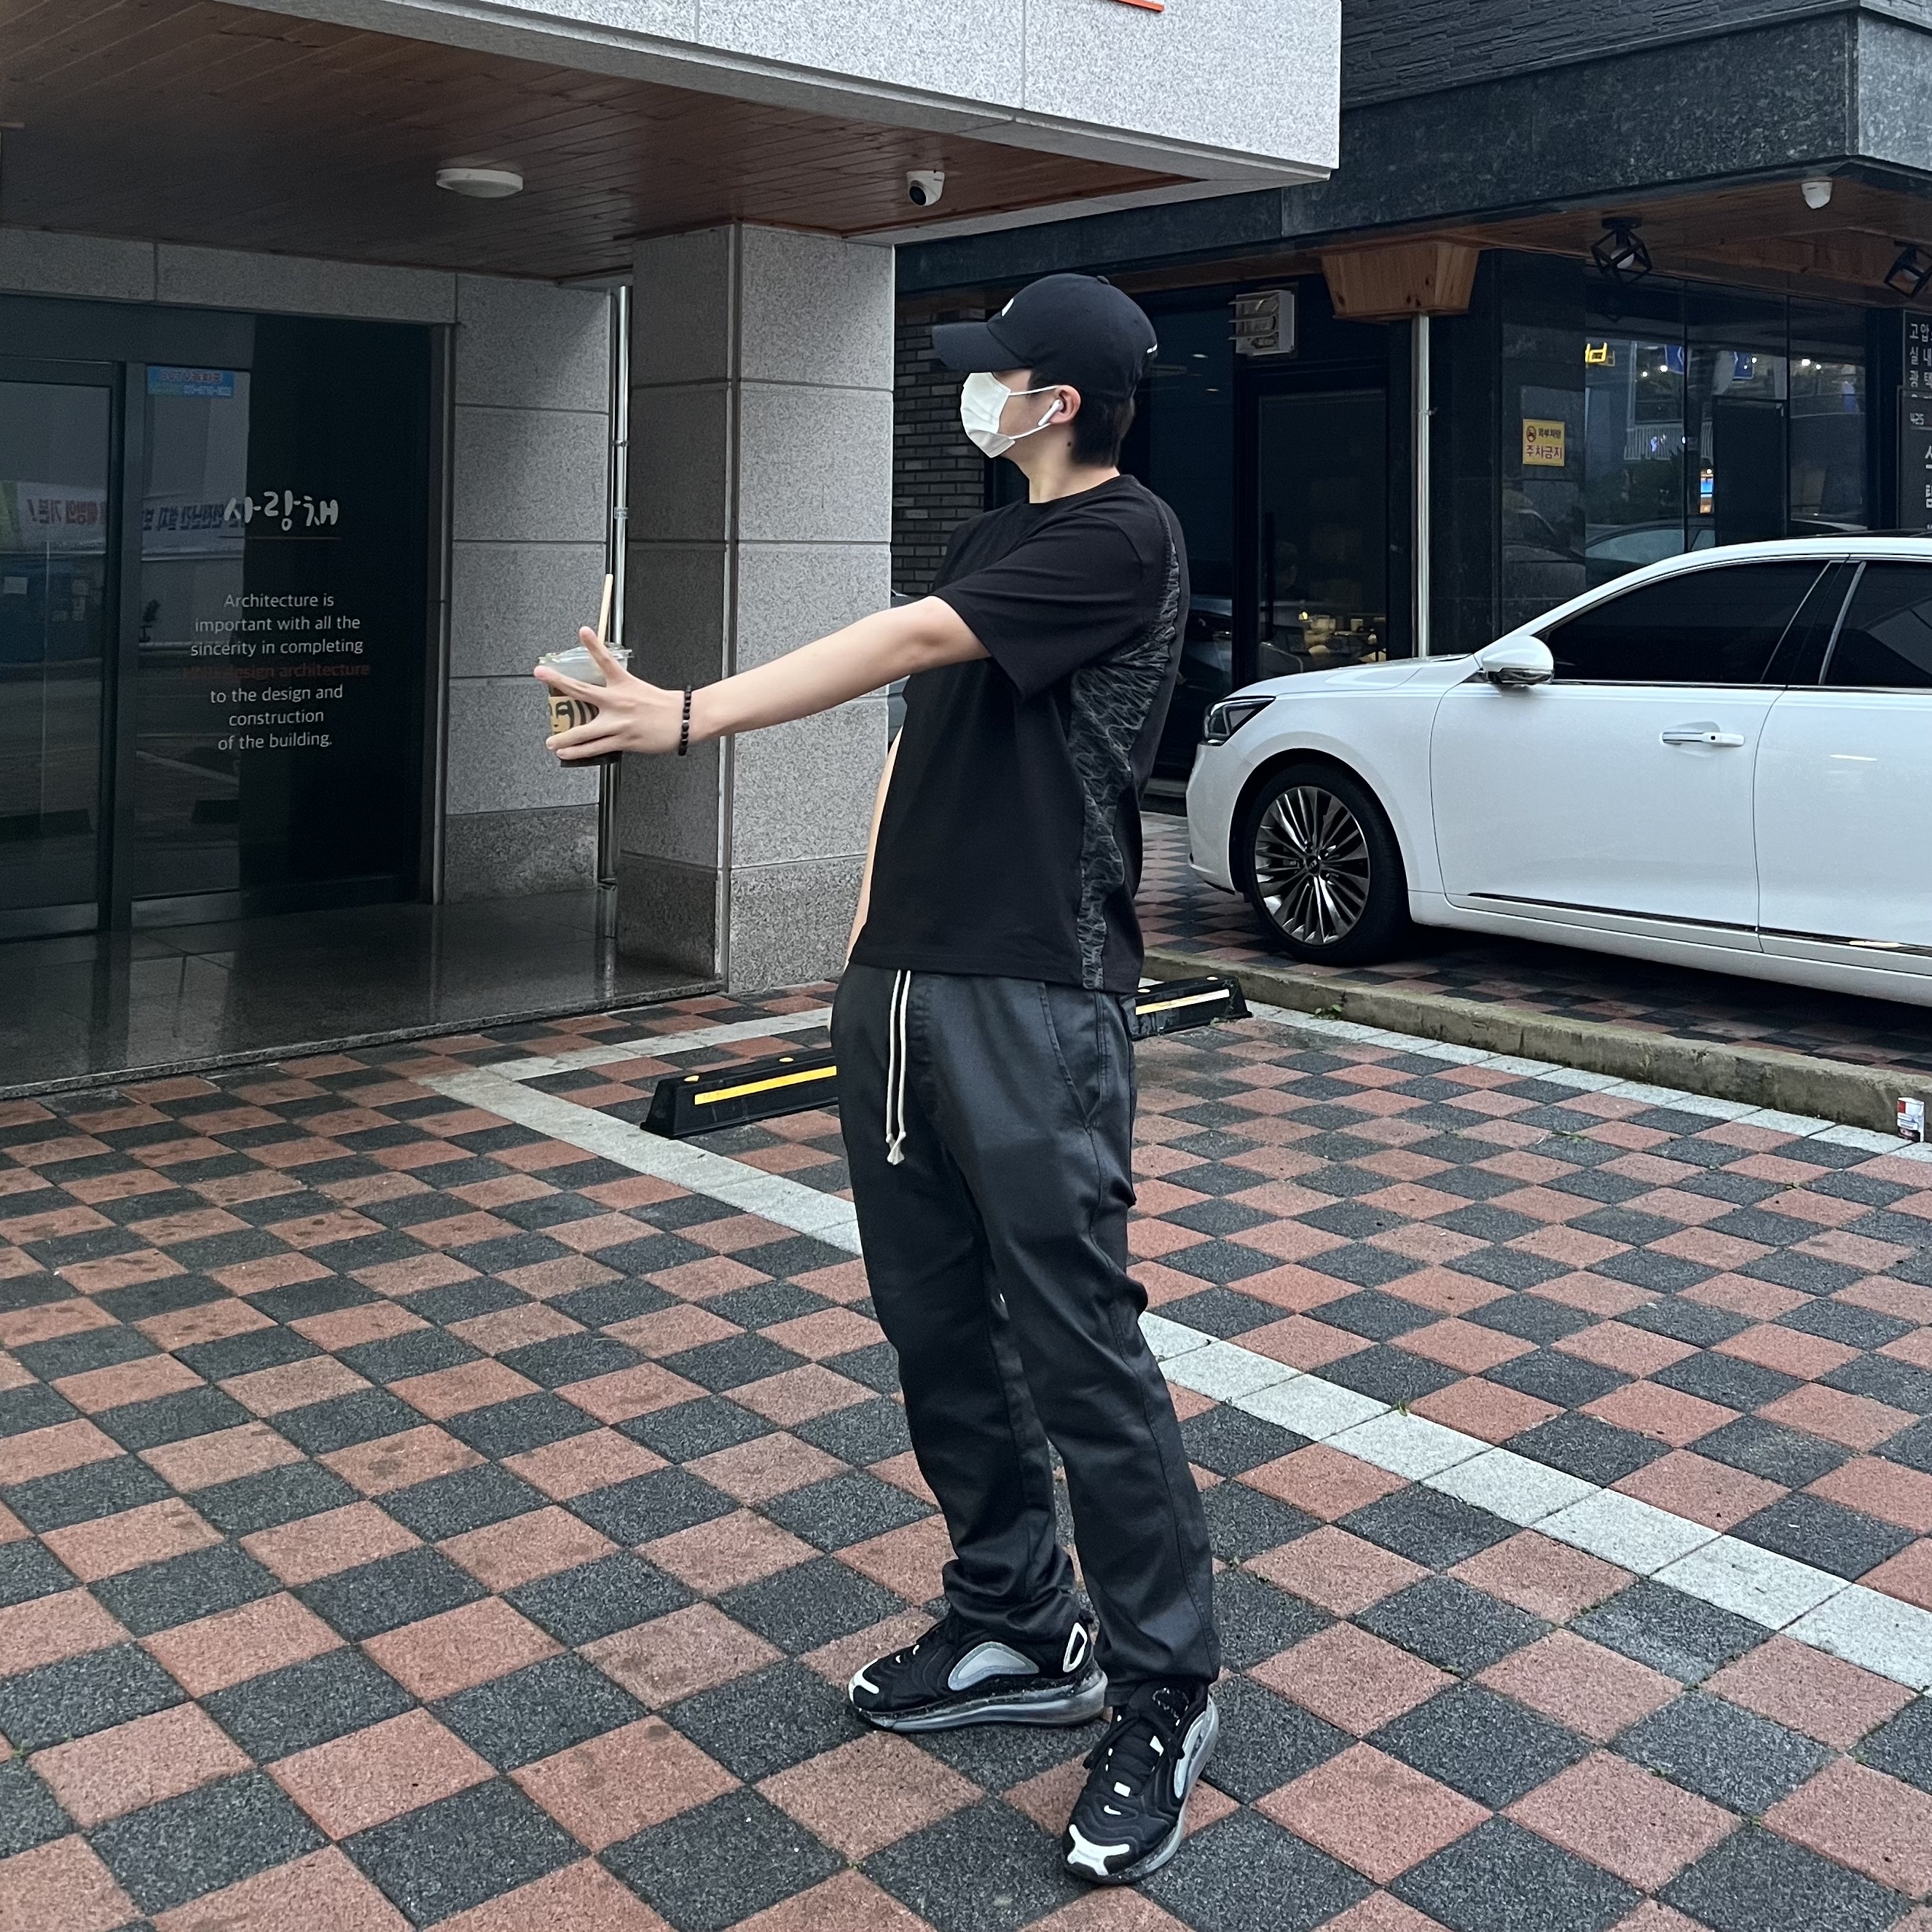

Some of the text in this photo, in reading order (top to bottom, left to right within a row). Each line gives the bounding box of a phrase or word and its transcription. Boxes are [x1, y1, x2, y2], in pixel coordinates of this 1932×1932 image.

[1909, 323, 1932, 342] 고압
[1525, 444, 1563, 460] 주차금지
[224, 490, 339, 531] 사랑채
[223, 593, 334, 608] Architecture is
[195, 616, 361, 634] important with all the
[190, 638, 364, 657] sincerity in completing
[278, 662, 370, 678] architecture
[211, 684, 343, 703] to the design and
[229, 709, 324, 726] construction
[218, 732, 333, 750] of the building.
